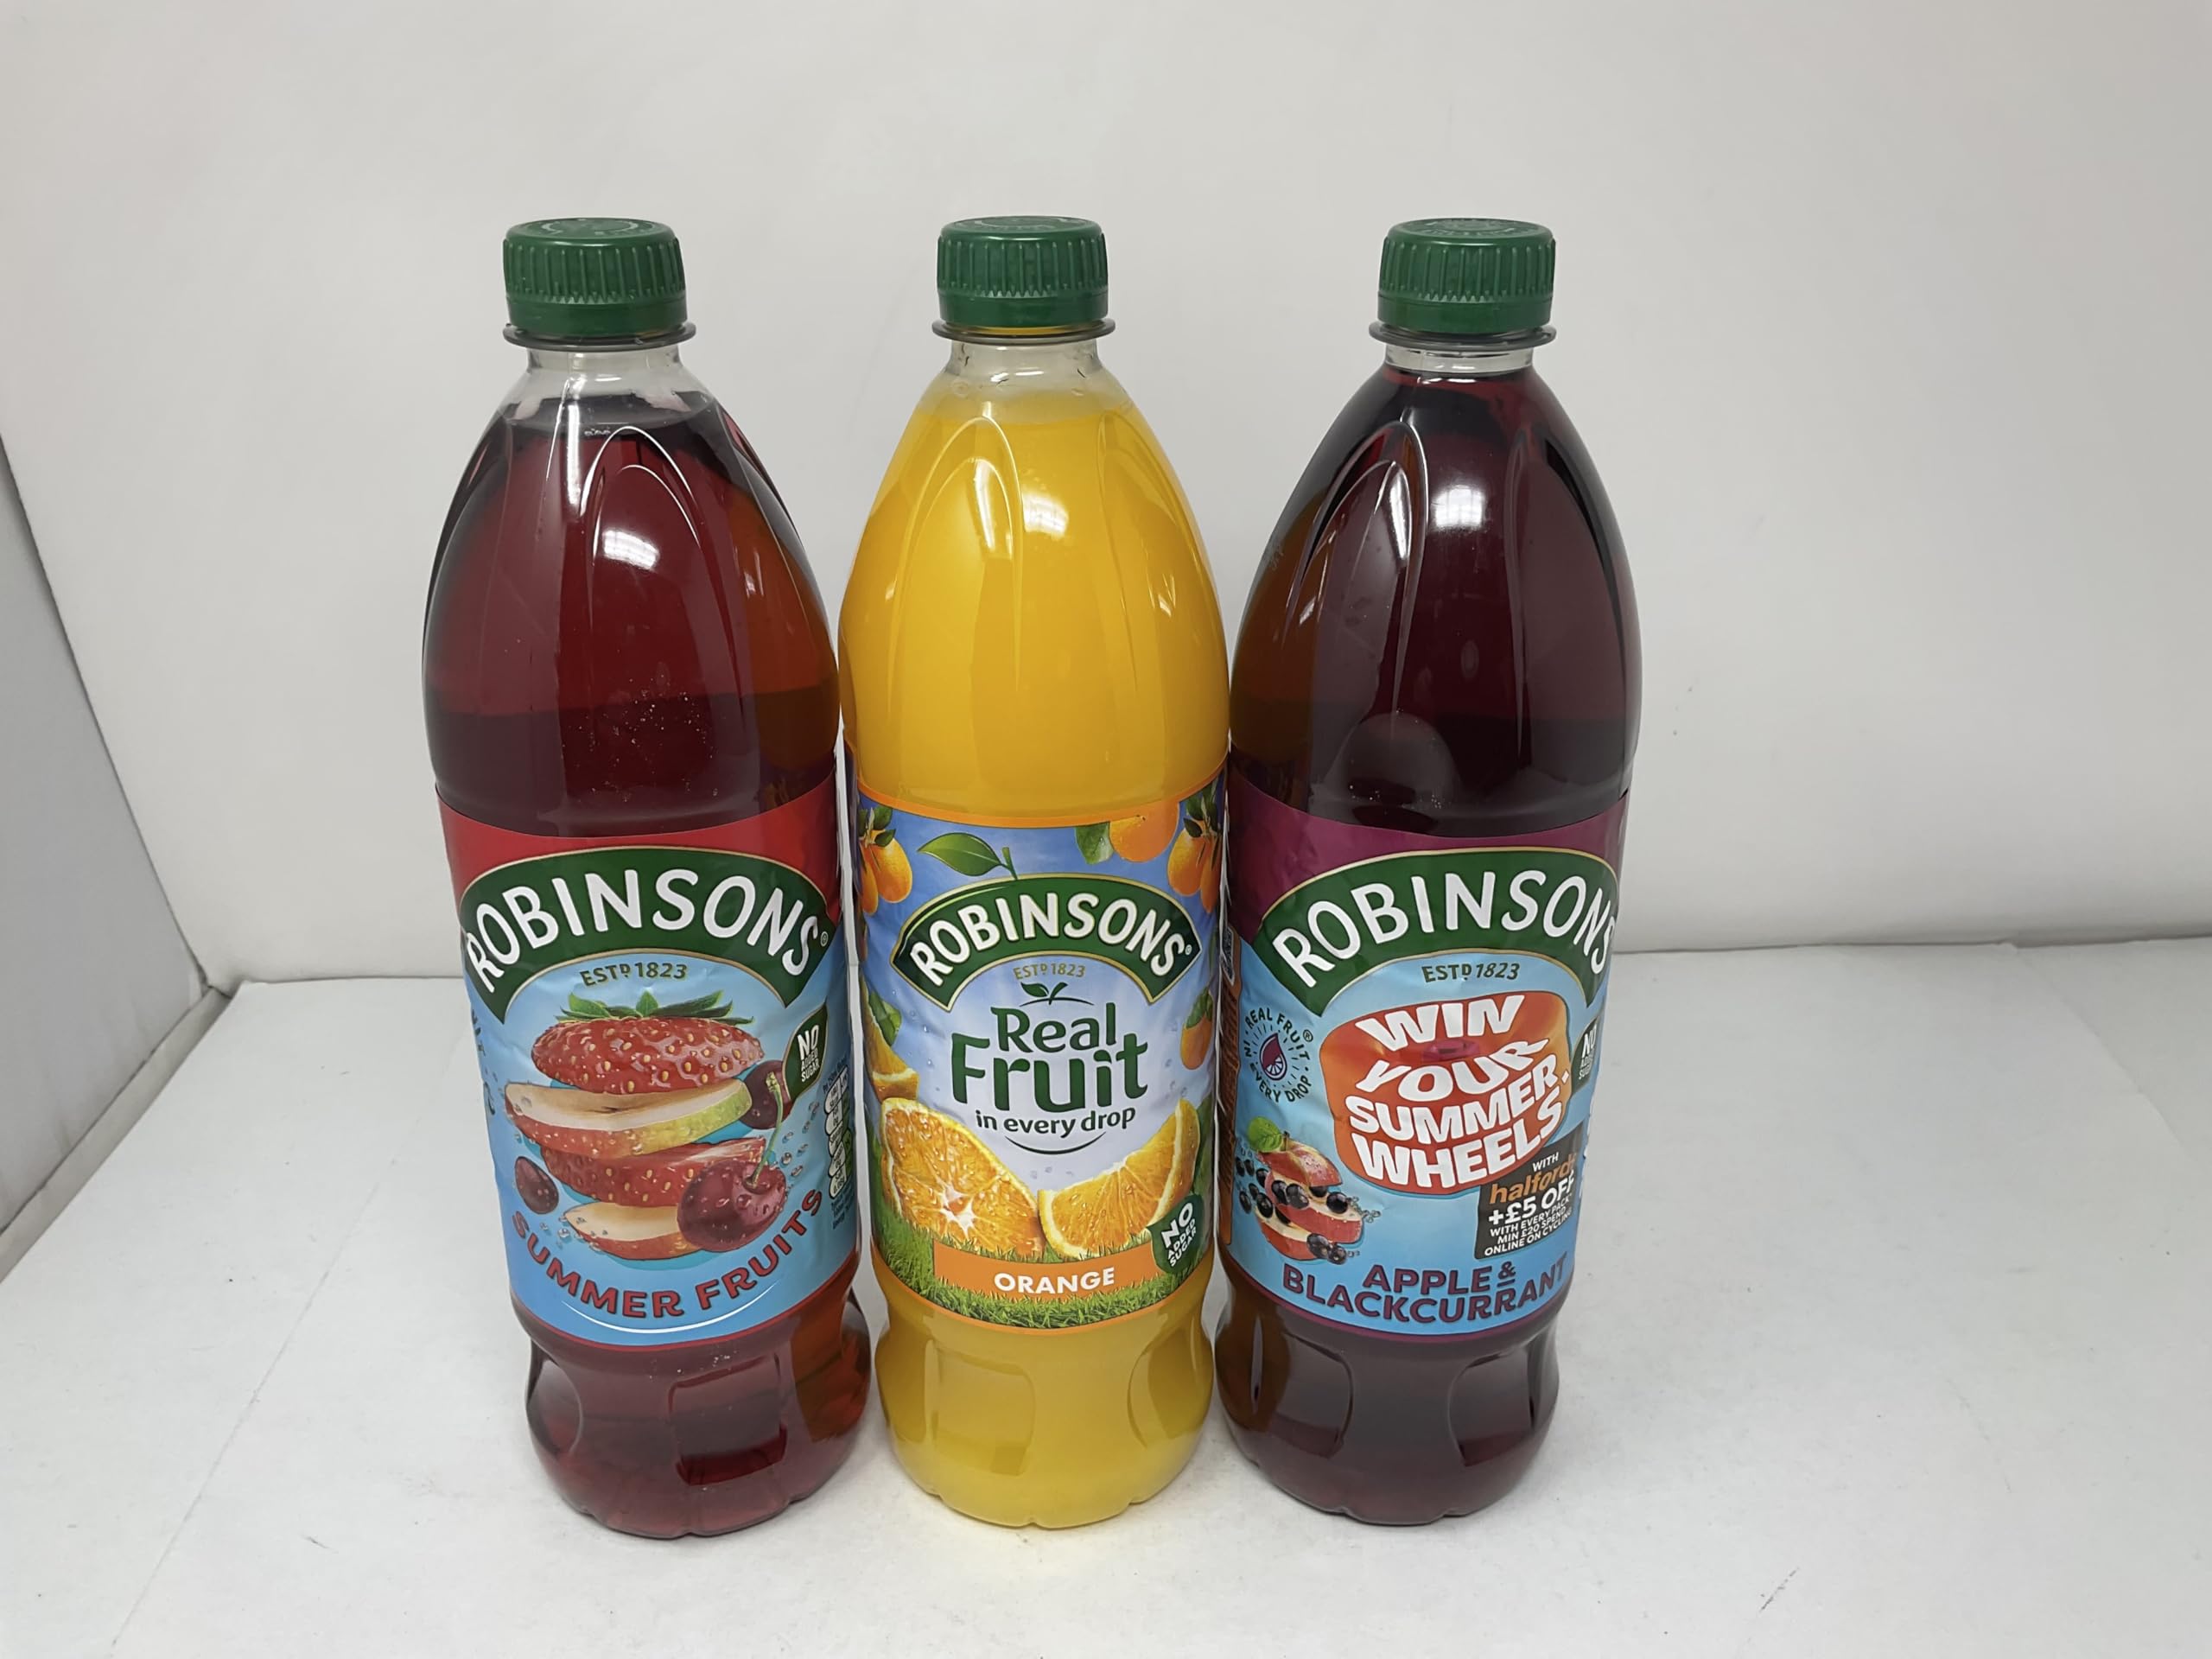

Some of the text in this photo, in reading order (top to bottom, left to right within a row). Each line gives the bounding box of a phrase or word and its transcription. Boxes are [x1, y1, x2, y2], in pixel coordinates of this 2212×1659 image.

[1272, 869, 1616, 988] ROBINSONS
[634, 962, 688, 979] 1823
[1051, 963, 1086, 978] 1823
[1476, 962, 1521, 980] 1823
[798, 1025, 819, 1061] NO
[990, 1002, 1116, 1052] Real
[1245, 1007, 1310, 1060] REAL FRUIT
[1355, 994, 1525, 1052] WIN
[951, 1032, 1148, 1113] Fruit
[1284, 1075, 1312, 1103] DROP
[1356, 1038, 1550, 1102] YOUR
[976, 1107, 1136, 1138] in every drop
[1351, 1086, 1563, 1188] WHEELS
[1532, 1152, 1560, 1172] WITH
[1489, 1169, 1574, 1225] +£5 OFF
[1161, 1202, 1193, 1249] NO
[1168, 1218, 1195, 1260] ADDED
[1484, 1237, 1525, 1256] ONLINE
[1527, 1230, 1541, 1243] ON
[1490, 1224, 1518, 1237] WITH
[1521, 1210, 1552, 1229] EVERY
[1497, 1206, 1567, 1244] MIN £20 SPEND
[512, 1211, 685, 1319] SUMMER
[696, 1189, 823, 1310] FRUITS
[1170, 1227, 1197, 1267] SUGAR
[994, 1267, 1116, 1294] ORANGE
[1282, 1253, 1567, 1325] BLACKCURRANT
[1363, 1261, 1516, 1295] APPLE &
